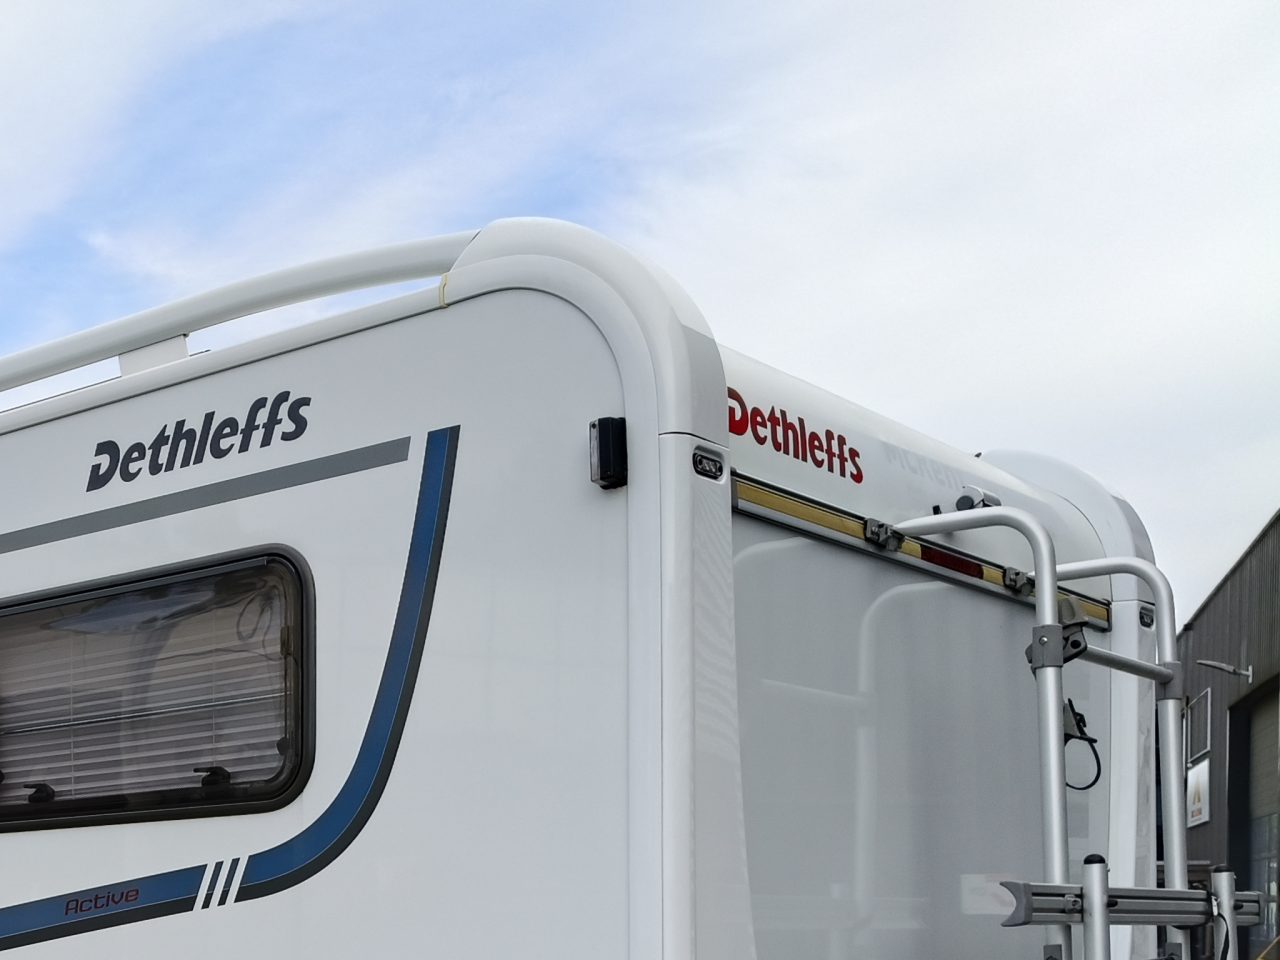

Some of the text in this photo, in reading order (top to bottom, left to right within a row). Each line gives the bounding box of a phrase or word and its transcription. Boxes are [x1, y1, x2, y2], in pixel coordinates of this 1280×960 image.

[86, 390, 312, 492] Dethleffs
[727, 386, 863, 484] Dethleffs
[64, 888, 140, 916] Active
